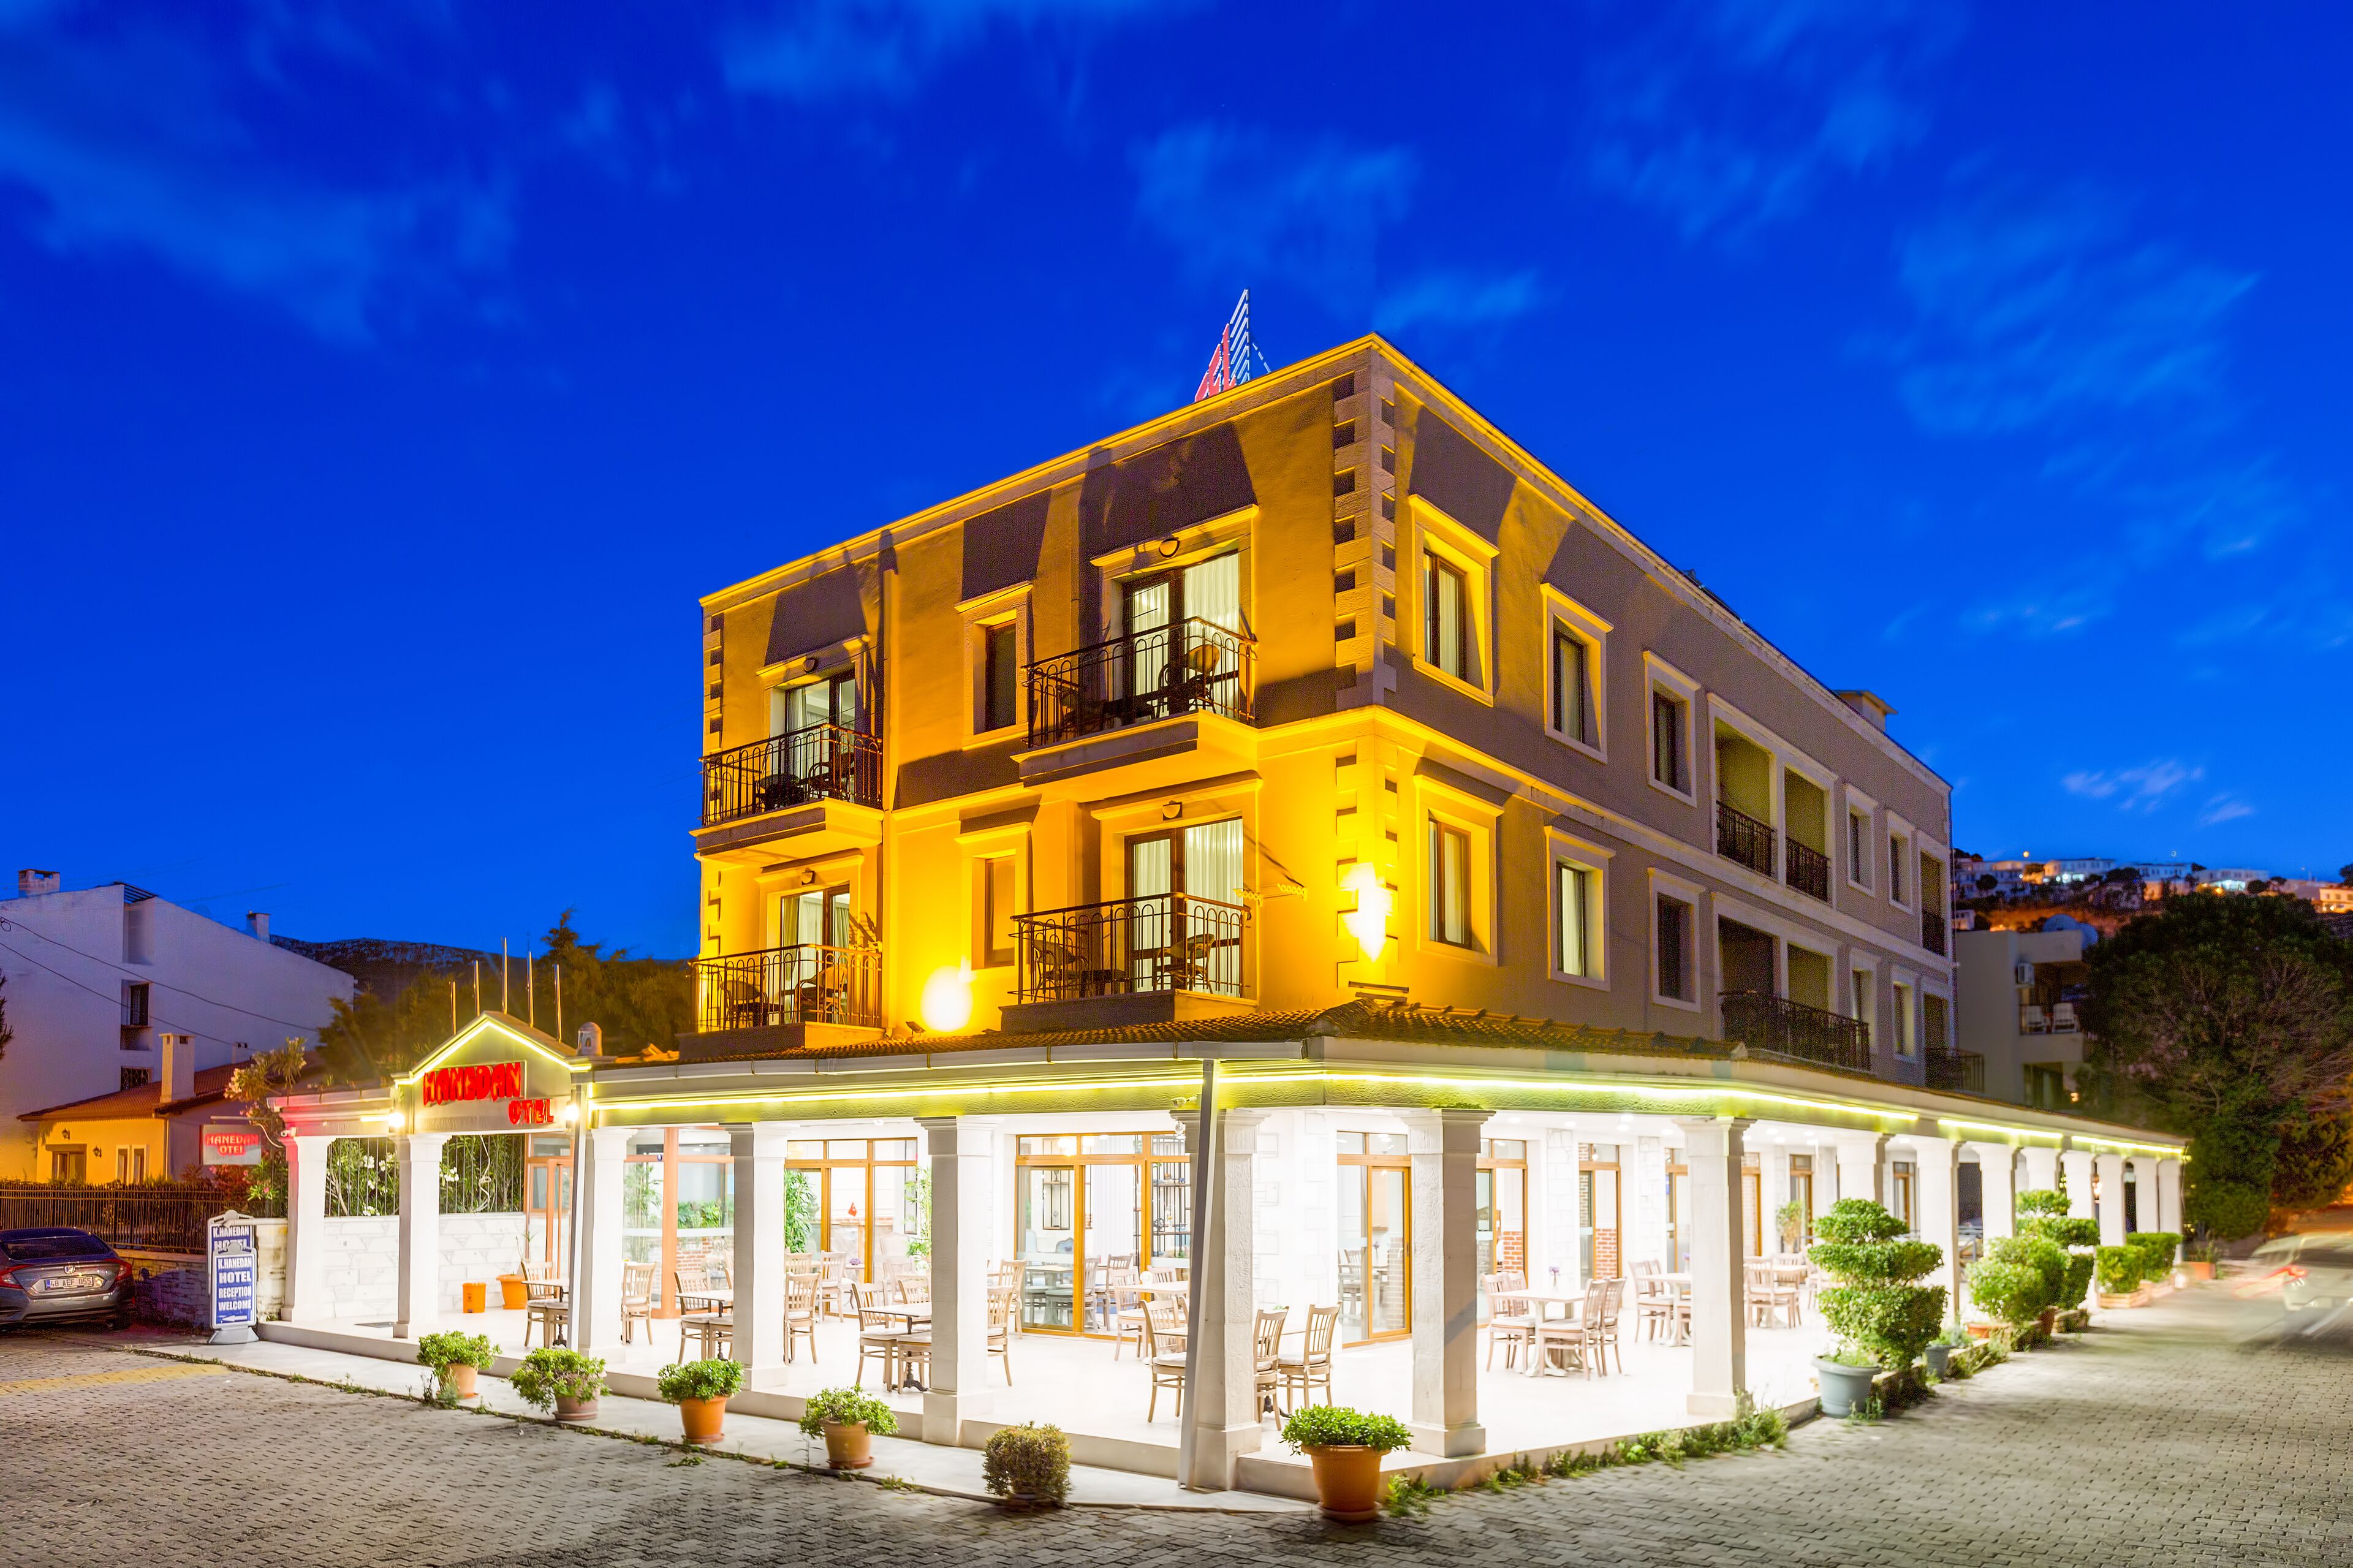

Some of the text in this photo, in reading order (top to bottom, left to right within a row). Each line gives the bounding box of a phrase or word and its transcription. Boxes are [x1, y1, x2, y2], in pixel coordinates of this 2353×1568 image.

[423, 1062, 521, 1106] HANEDAN
[509, 1099, 554, 1125] OTEL
[206, 1134, 259, 1146] HANEDAN
[218, 1145, 245, 1156] OTEL
[213, 1226, 249, 1238] K.HANEDAN
[218, 1257, 252, 1269] K.HANEDAN
[219, 1271, 251, 1284] HOTEL
[218, 1286, 252, 1299] RECEPTION
[218, 1300, 252, 1311] WELCOME
